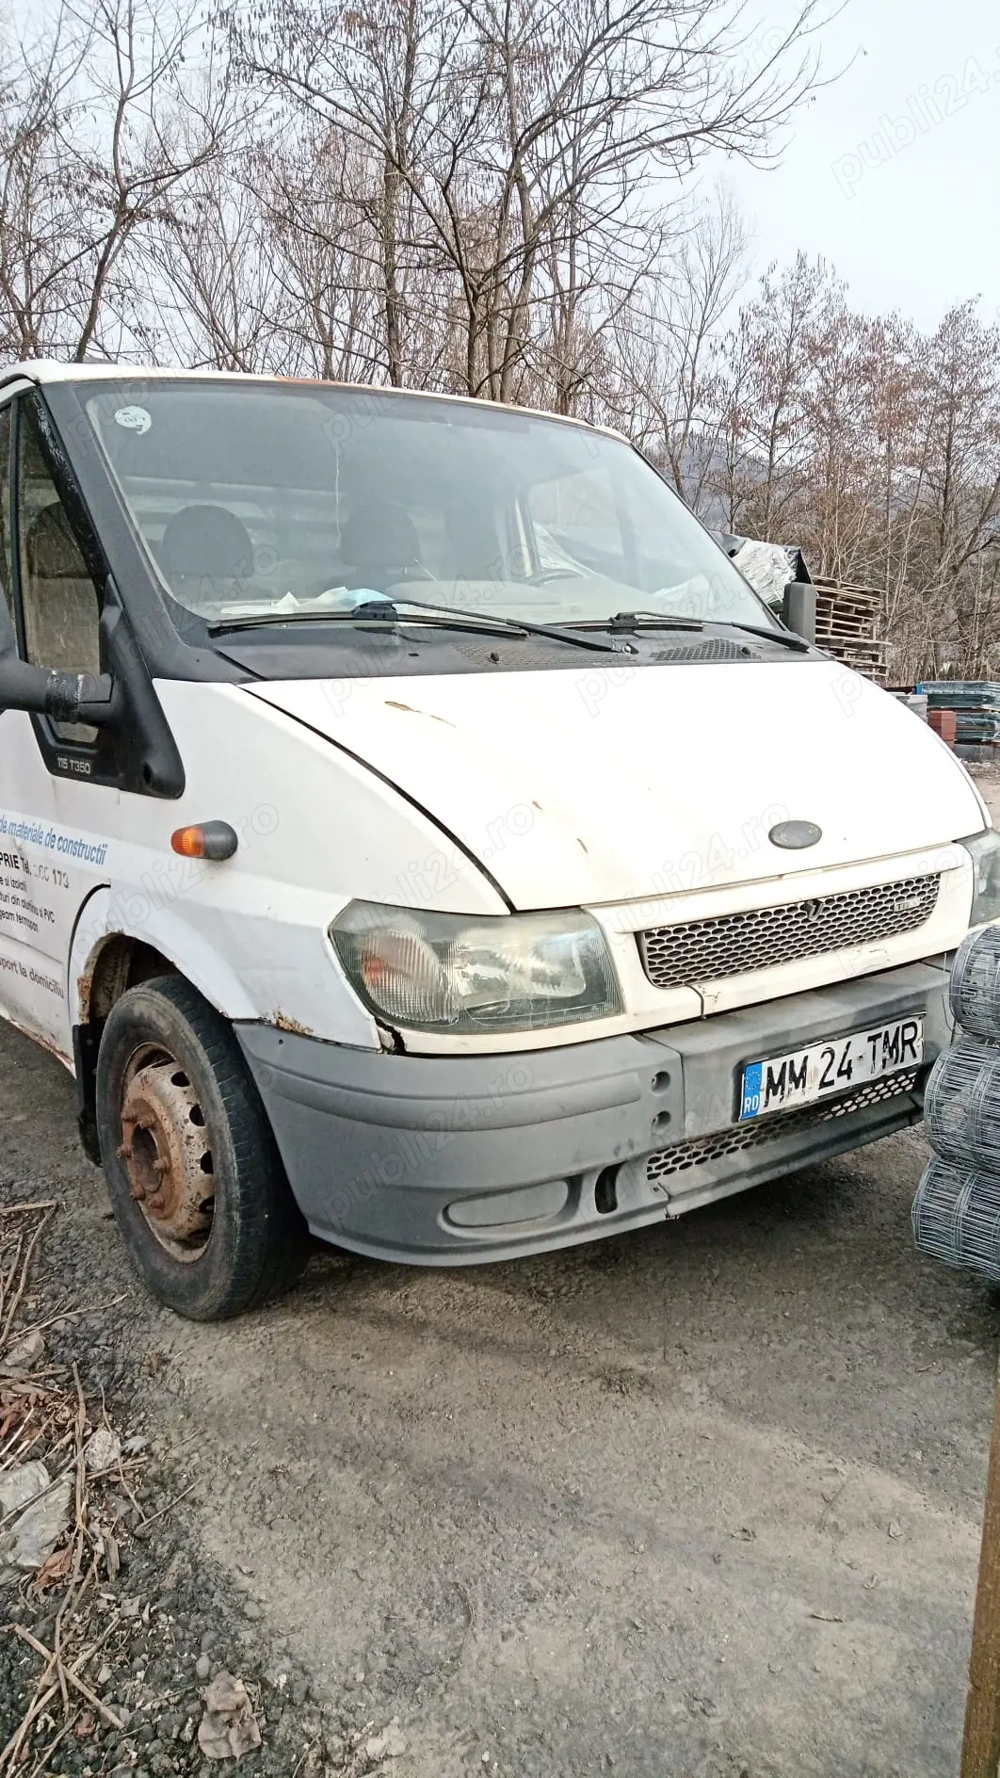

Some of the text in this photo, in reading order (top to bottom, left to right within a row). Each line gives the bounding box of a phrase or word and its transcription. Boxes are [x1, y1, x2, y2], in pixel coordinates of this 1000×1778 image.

[70, 759, 91, 774] T350
[8, 820, 44, 845] materiale
[44, 827, 56, 849] de
[57, 836, 108, 865] constructii
[18, 960, 28, 978] la
[764, 1021, 918, 1108] MM 24 TMR
[744, 1096, 759, 1112] RO
